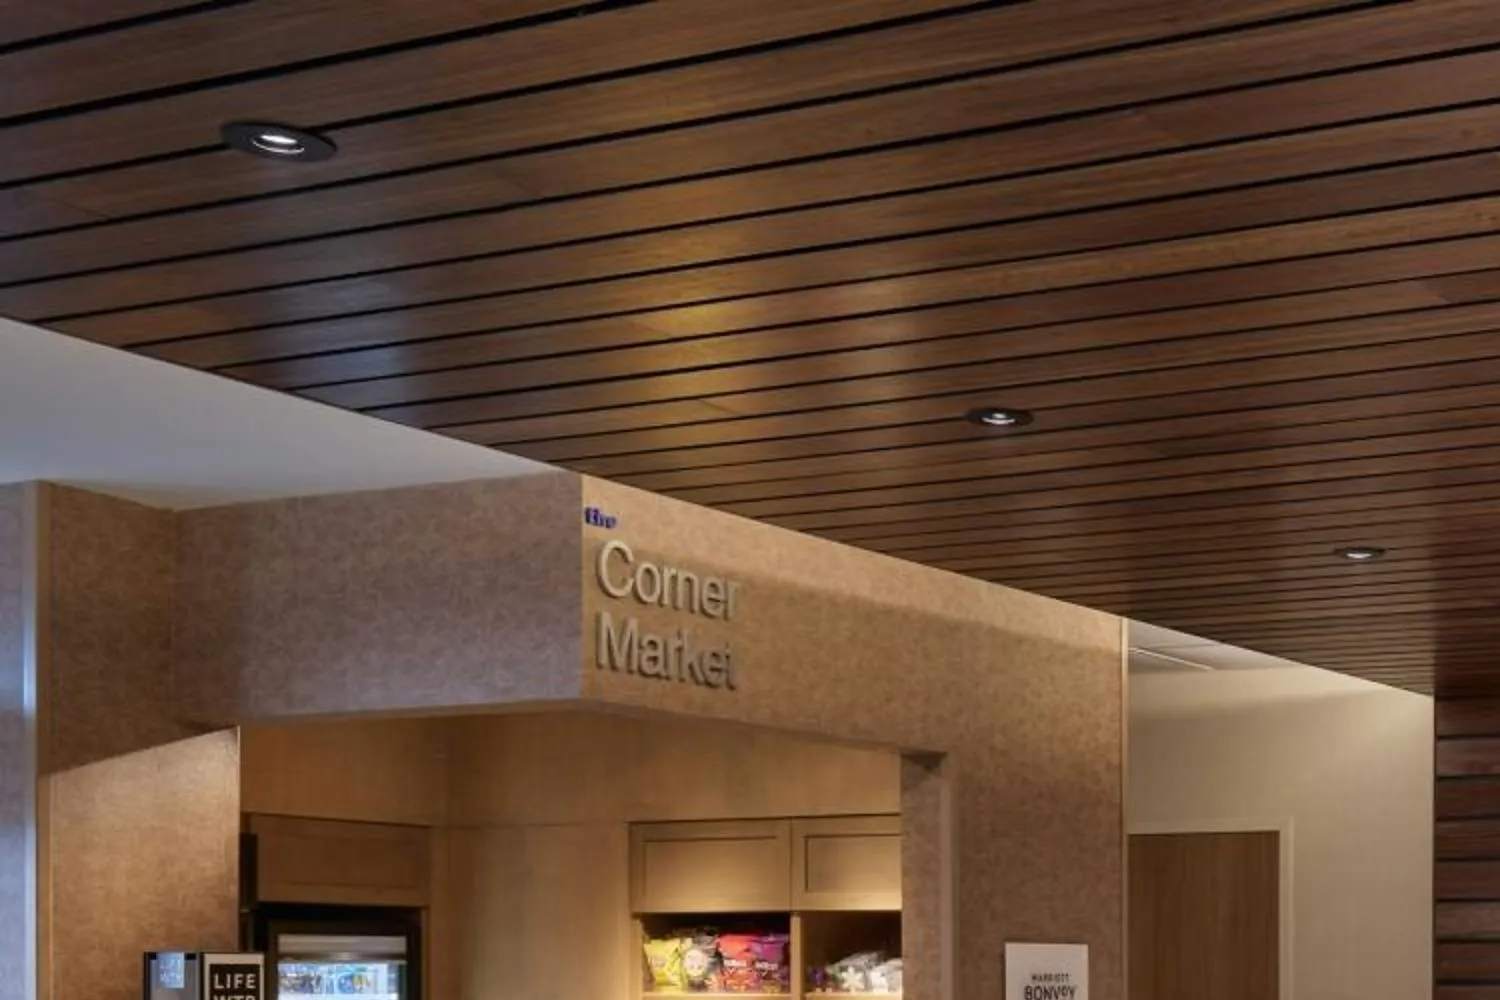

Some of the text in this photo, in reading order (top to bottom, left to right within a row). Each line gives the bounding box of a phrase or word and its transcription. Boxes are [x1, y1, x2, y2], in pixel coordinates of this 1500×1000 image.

[584, 507, 617, 529] the
[596, 540, 741, 621] Corner
[596, 612, 737, 691] Market
[214, 973, 256, 989] LIFE
